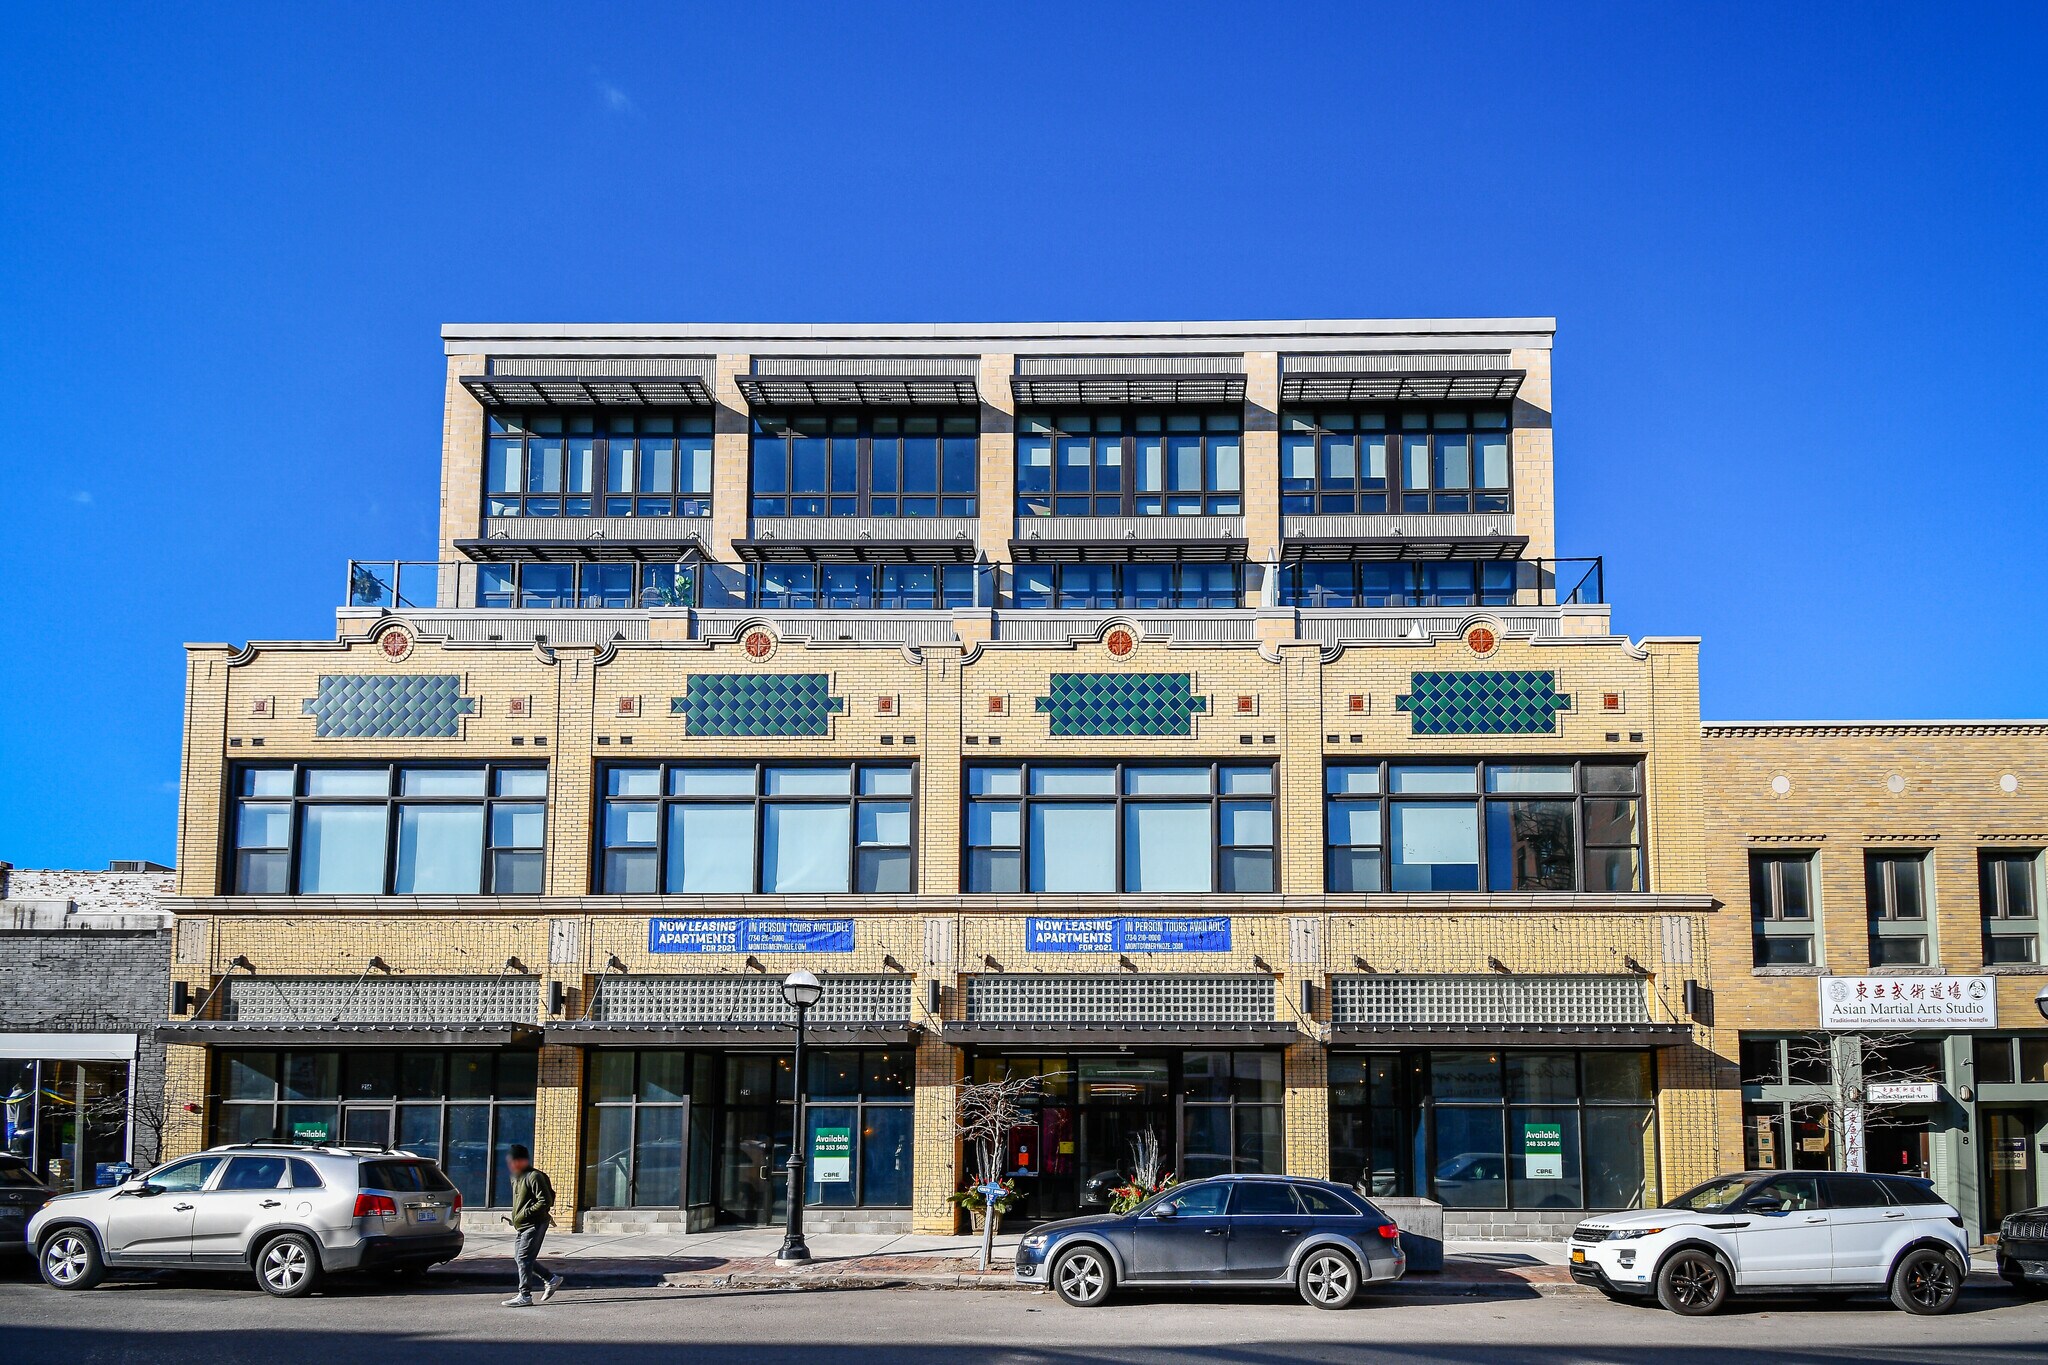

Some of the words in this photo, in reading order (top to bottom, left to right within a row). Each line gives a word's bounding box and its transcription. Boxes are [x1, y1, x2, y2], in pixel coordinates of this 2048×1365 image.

[659, 921, 686, 931] NOW
[688, 921, 737, 931] LEASING
[748, 922, 757, 932] IN
[759, 922, 787, 932] PERSON
[789, 922, 812, 932] TOURS
[813, 922, 850, 932] AVAILABLE
[1035, 920, 1063, 931] NOW
[1065, 920, 1113, 931] LEASING
[1125, 921, 1133, 932] IN
[1135, 921, 1163, 932] PERSON
[1165, 921, 1188, 932] TOURS
[1189, 921, 1226, 932] AVAILABLE
[659, 933, 736, 944] APARTMENTS
[1035, 932, 1113, 943] APARTMENTS
[701, 944, 716, 952] FOR
[717, 944, 736, 952] 2021
[1832, 1003, 1866, 1015] Asian
[1870, 1003, 1914, 1015] Martial
[1917, 1003, 1942, 1015] Arts
[1946, 1002, 1984, 1014] Studio
[1968, 1016, 1989, 1024] Kungfu
[293, 1130, 326, 1138] Available
[815, 1135, 849, 1143] Available
[1525, 1130, 1560, 1139] Available
